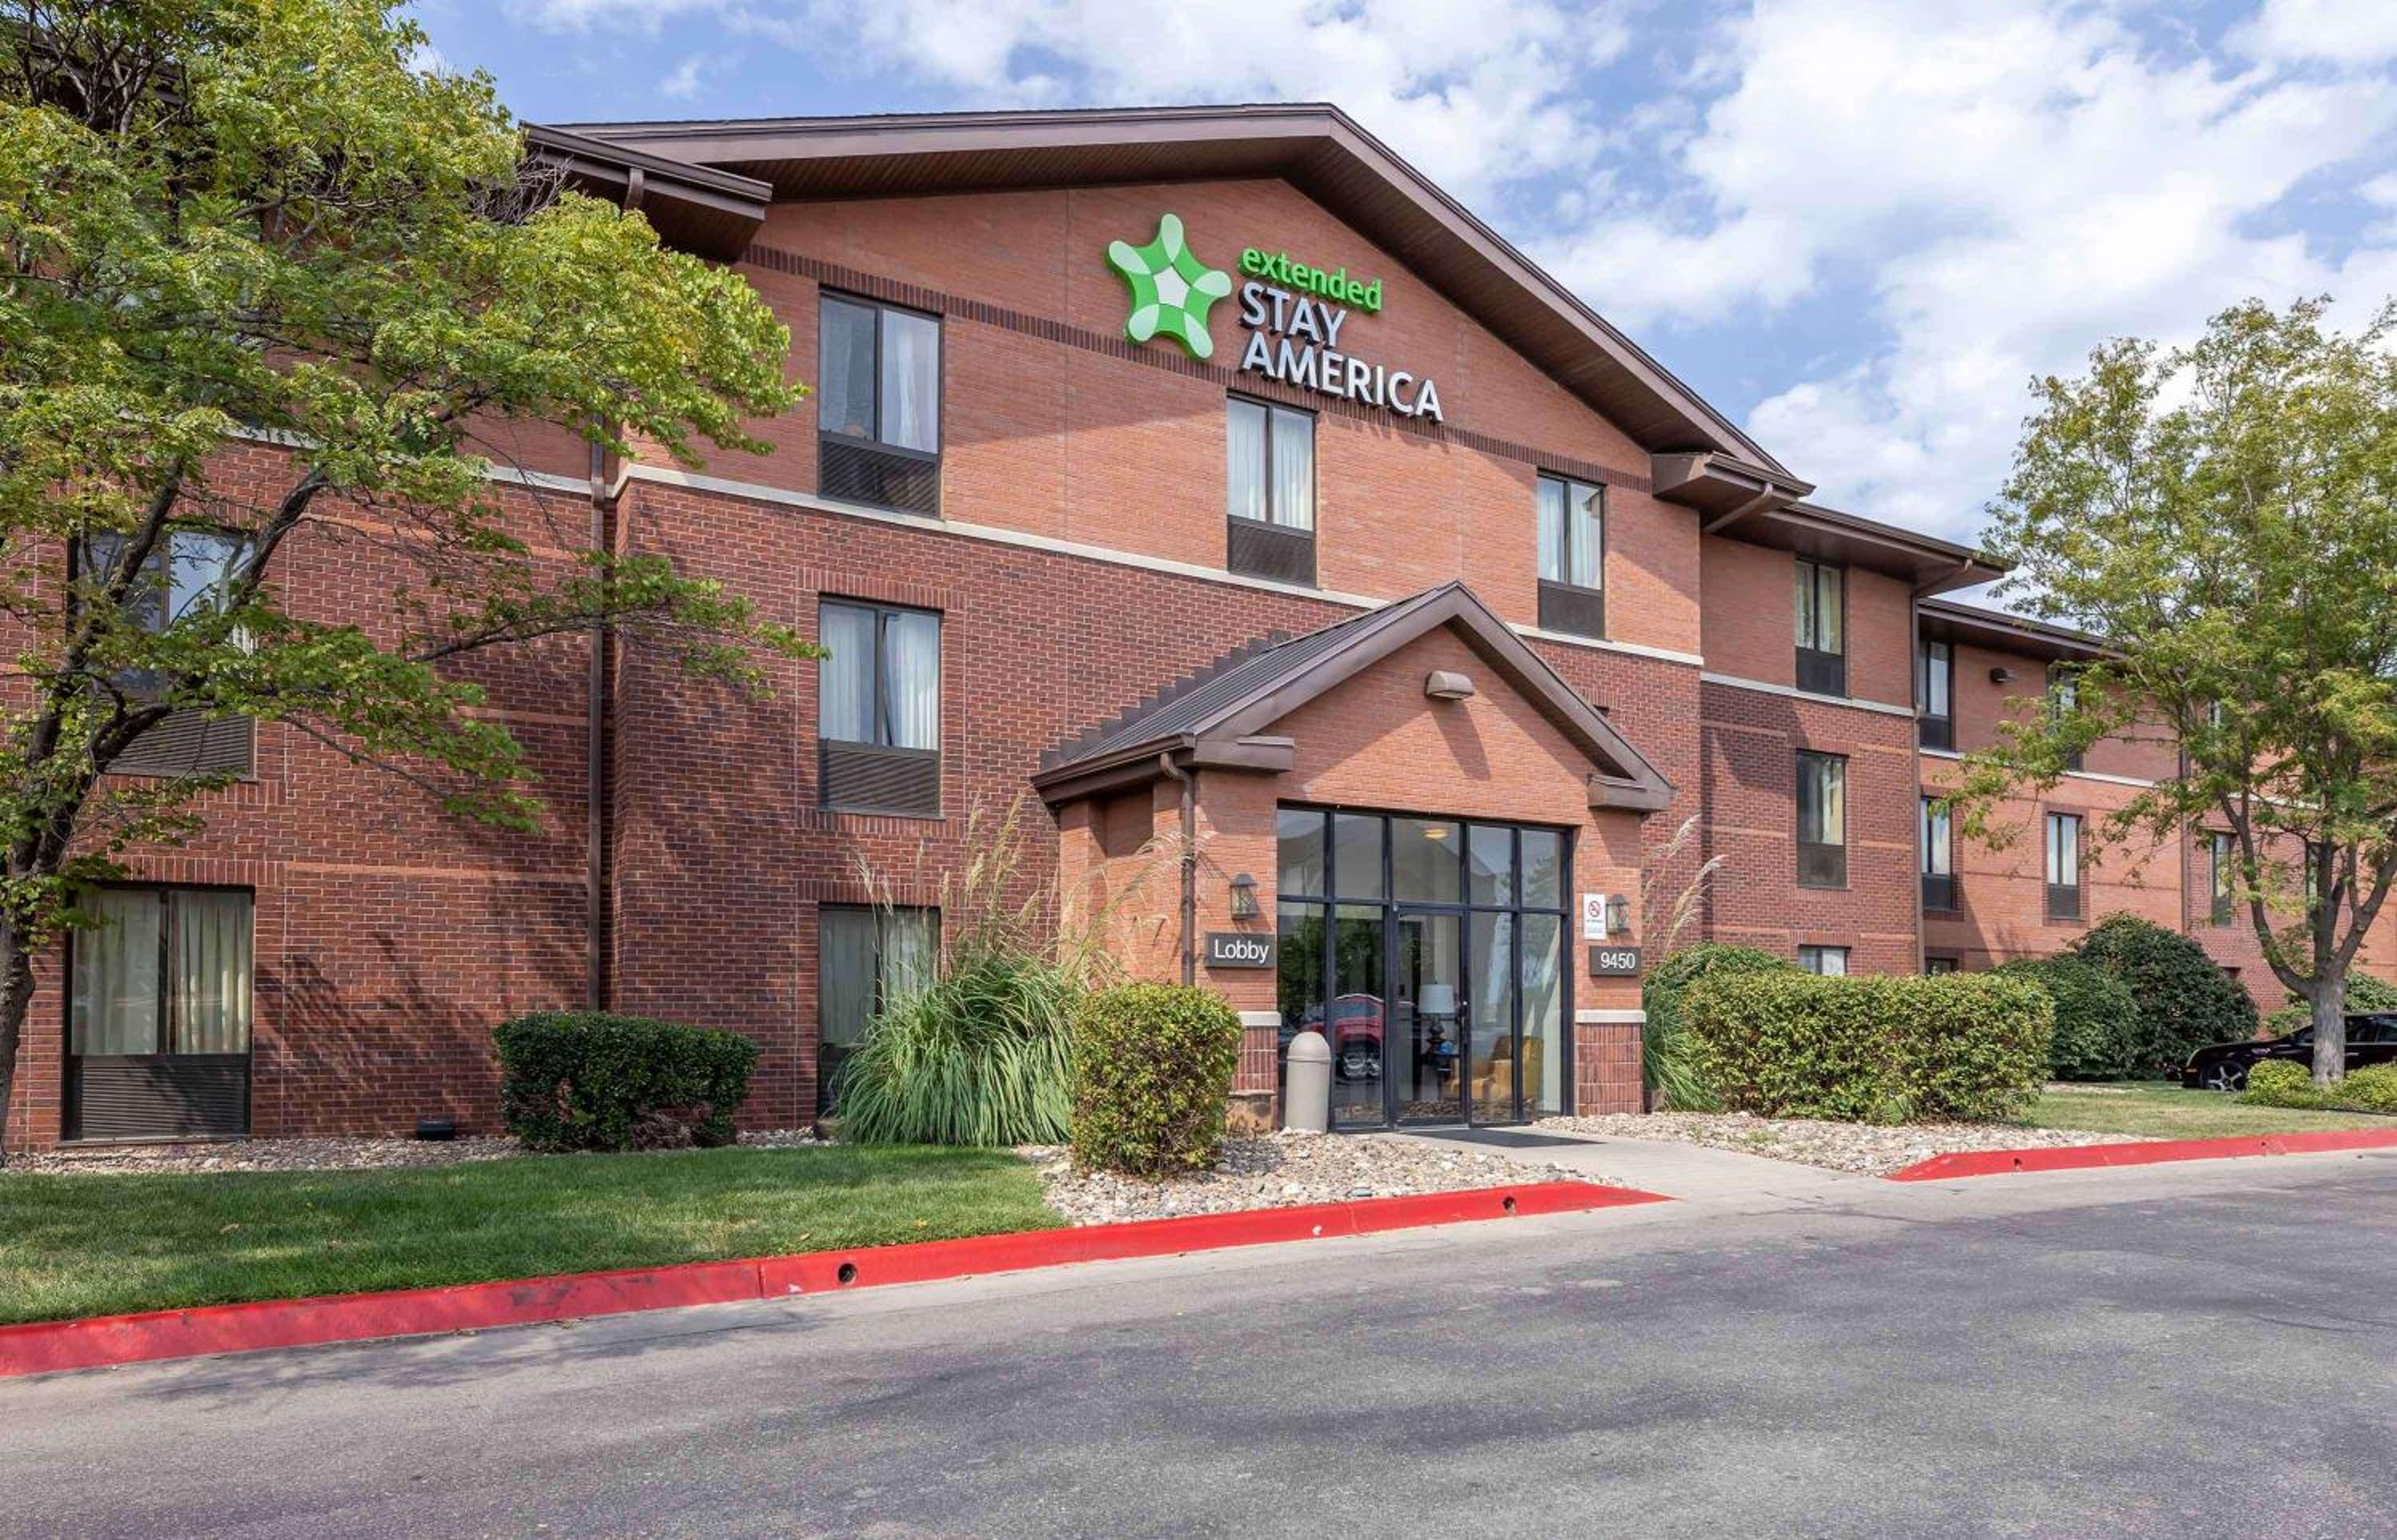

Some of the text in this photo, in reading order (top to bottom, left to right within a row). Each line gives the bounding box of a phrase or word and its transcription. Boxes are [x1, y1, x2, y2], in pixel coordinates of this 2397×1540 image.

[1240, 247, 1382, 312] extended
[1241, 281, 1346, 347] STAY
[1242, 331, 1444, 422] AMERICA
[1214, 939, 1270, 964] Lobby
[1600, 951, 1636, 969] 9450
